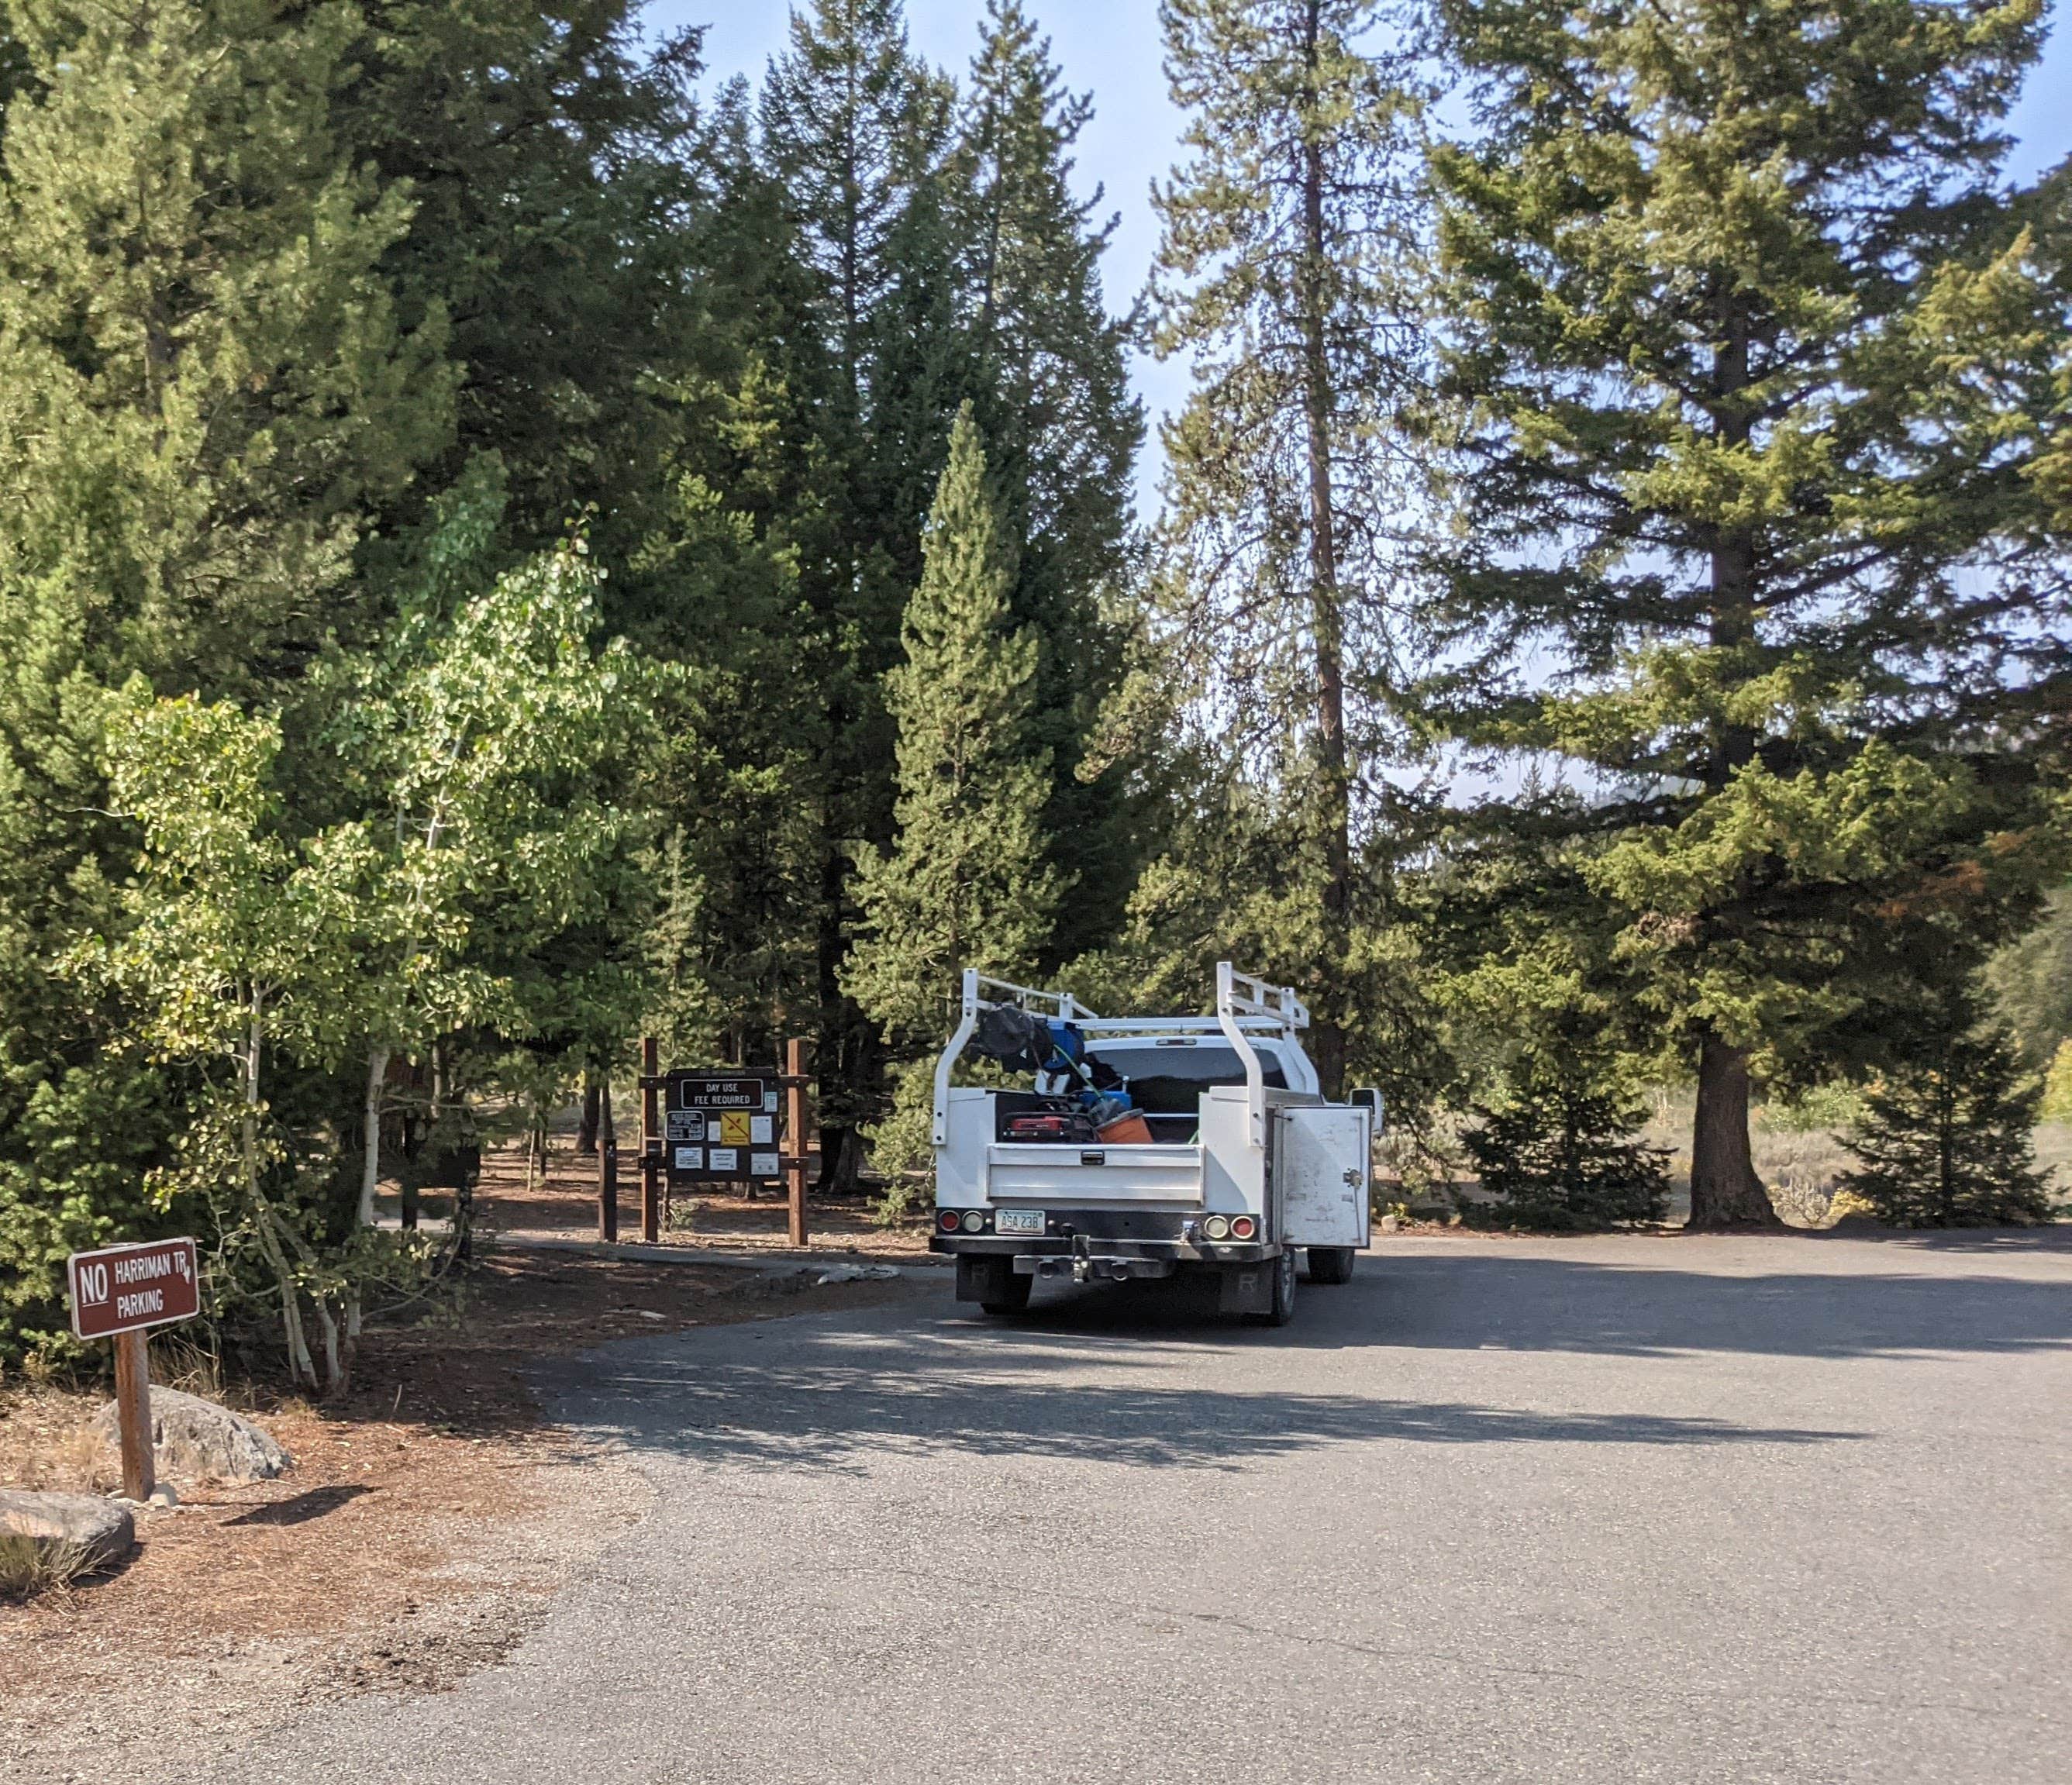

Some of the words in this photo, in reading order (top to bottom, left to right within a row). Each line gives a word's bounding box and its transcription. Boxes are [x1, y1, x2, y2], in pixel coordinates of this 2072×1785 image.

[695, 1095, 708, 1104] FEE
[712, 1094, 750, 1104] REQUIRED
[706, 1083, 720, 1092] DAY
[722, 1083, 739, 1093] USE
[115, 1253, 171, 1284] HARRIMAN
[173, 1250, 186, 1274] TR
[80, 1263, 108, 1304] NO
[117, 1288, 164, 1319] PARKING
